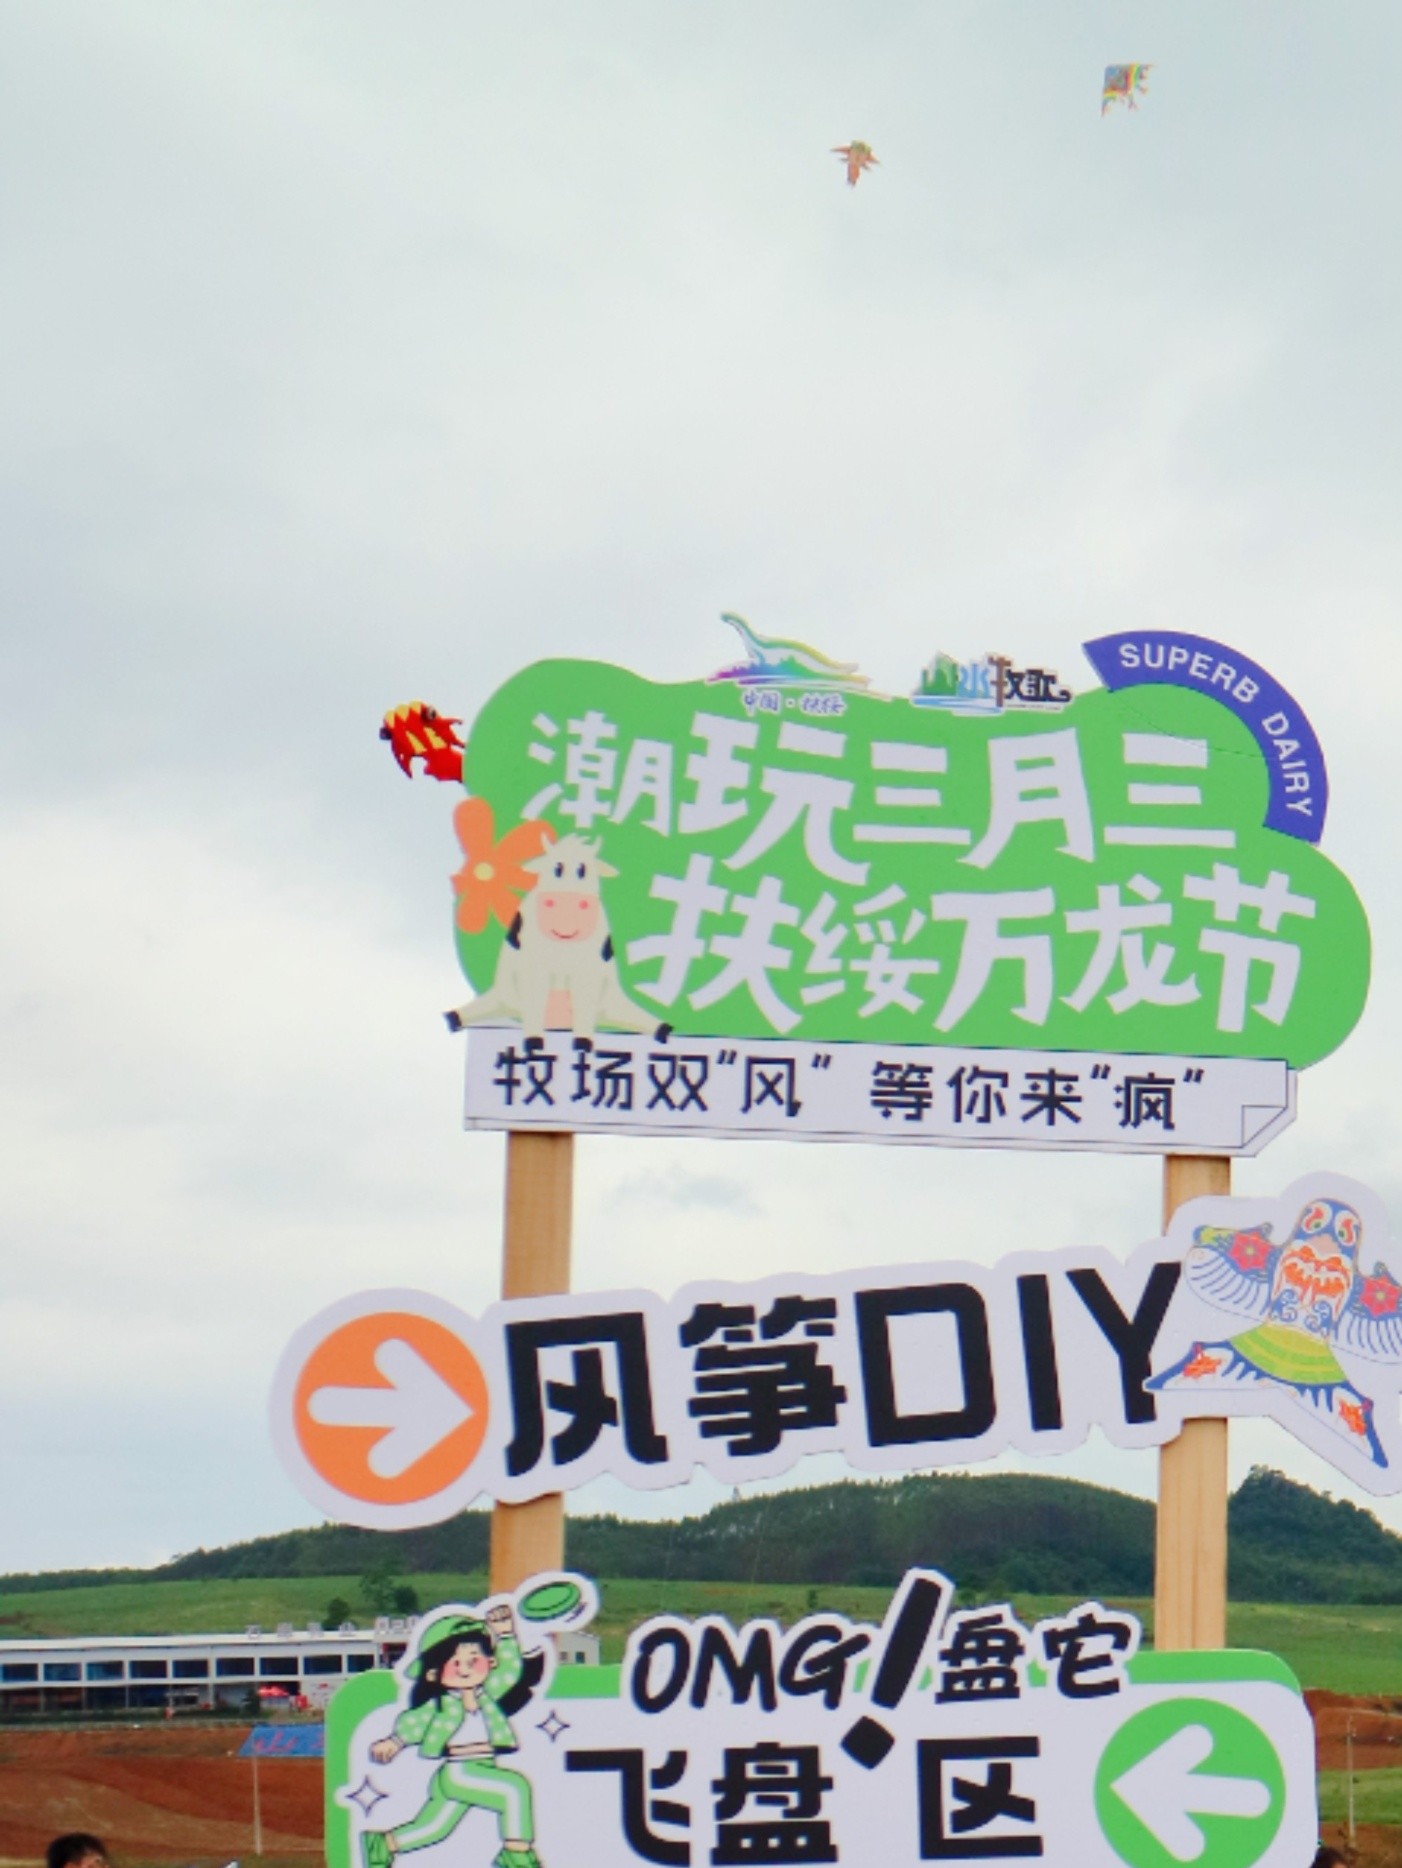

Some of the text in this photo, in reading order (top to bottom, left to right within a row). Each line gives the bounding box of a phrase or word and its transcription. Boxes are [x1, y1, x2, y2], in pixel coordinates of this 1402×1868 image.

[519, 710, 1238, 887] 潮玩三月三
[1119, 642, 1313, 817] SUPERB DAIRY
[626, 852, 1317, 1034] 扶绥万龙节
[504, 1261, 1182, 1478] 风筝DIY
[565, 1736, 1044, 1868] 飞盘区
